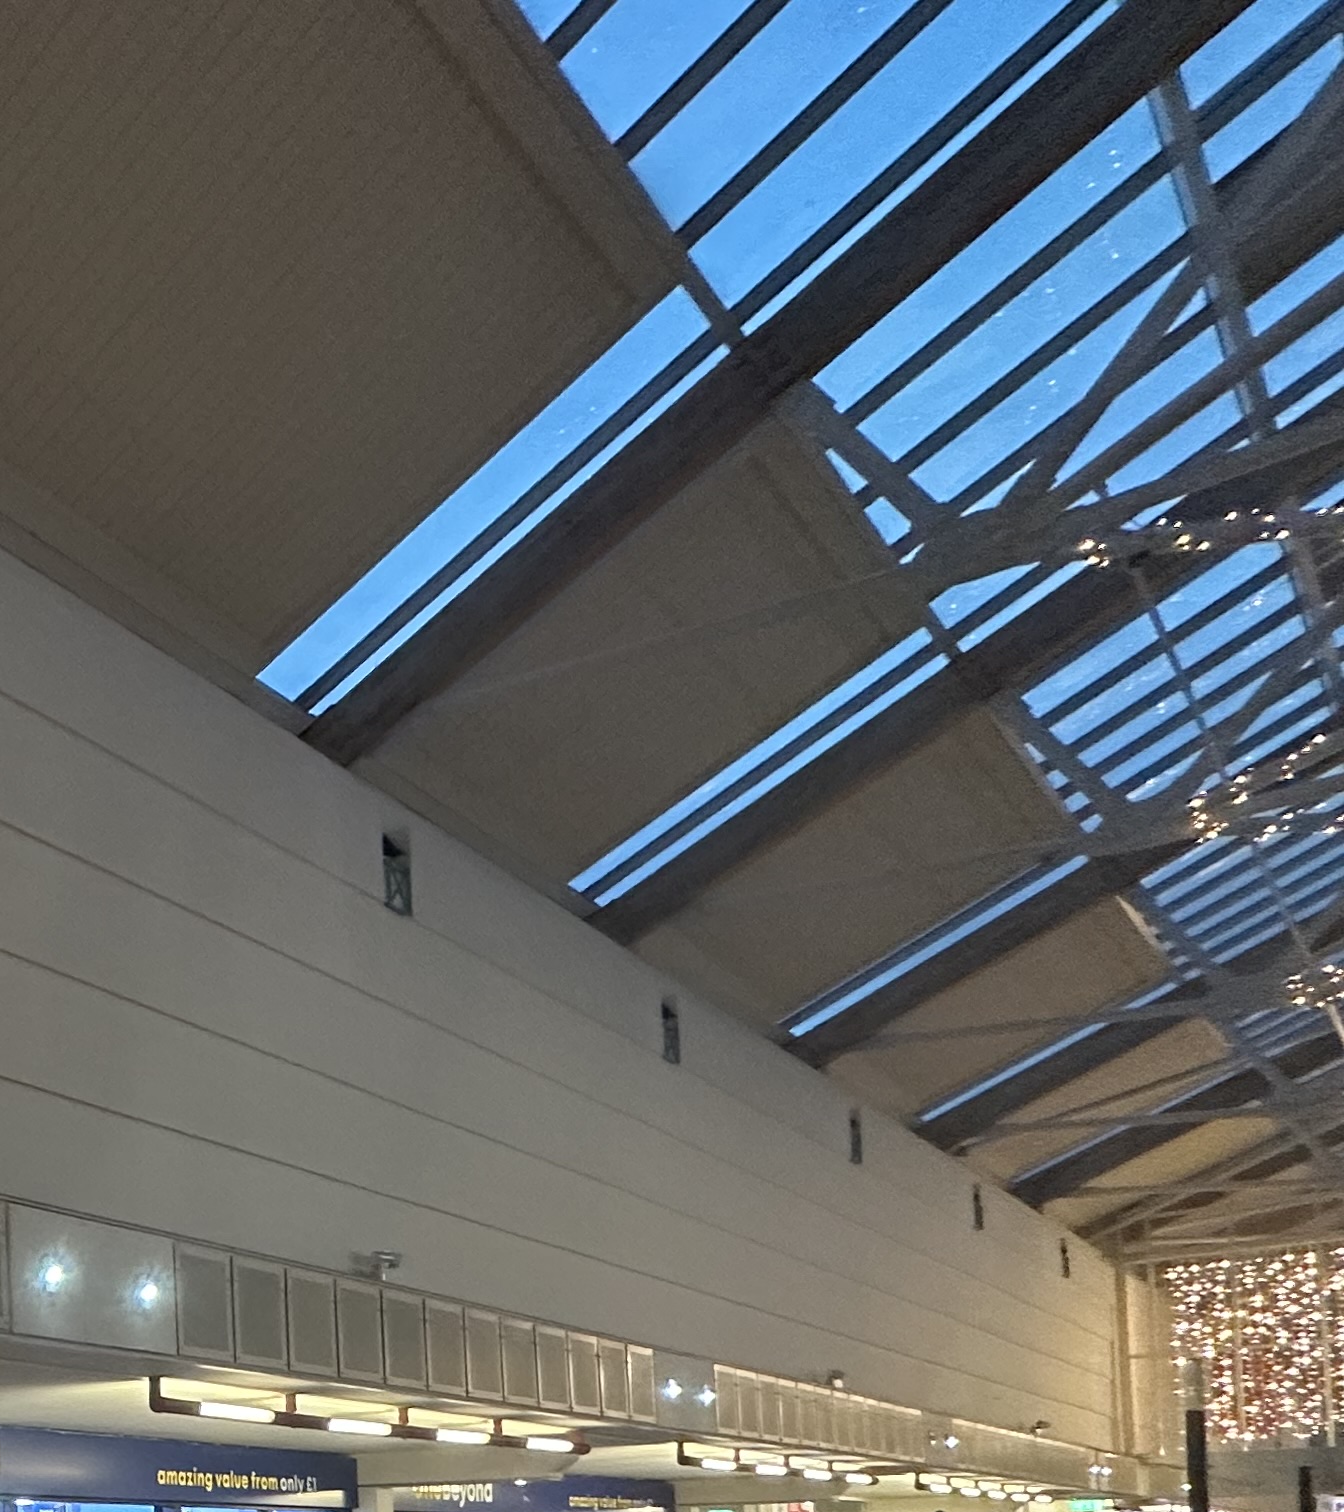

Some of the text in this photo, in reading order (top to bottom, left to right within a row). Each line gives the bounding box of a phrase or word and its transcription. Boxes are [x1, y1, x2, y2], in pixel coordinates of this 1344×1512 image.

[157, 1466, 213, 1491] amazing
[215, 1470, 249, 1490] value
[250, 1471, 278, 1491] from
[279, 1475, 304, 1495] only
